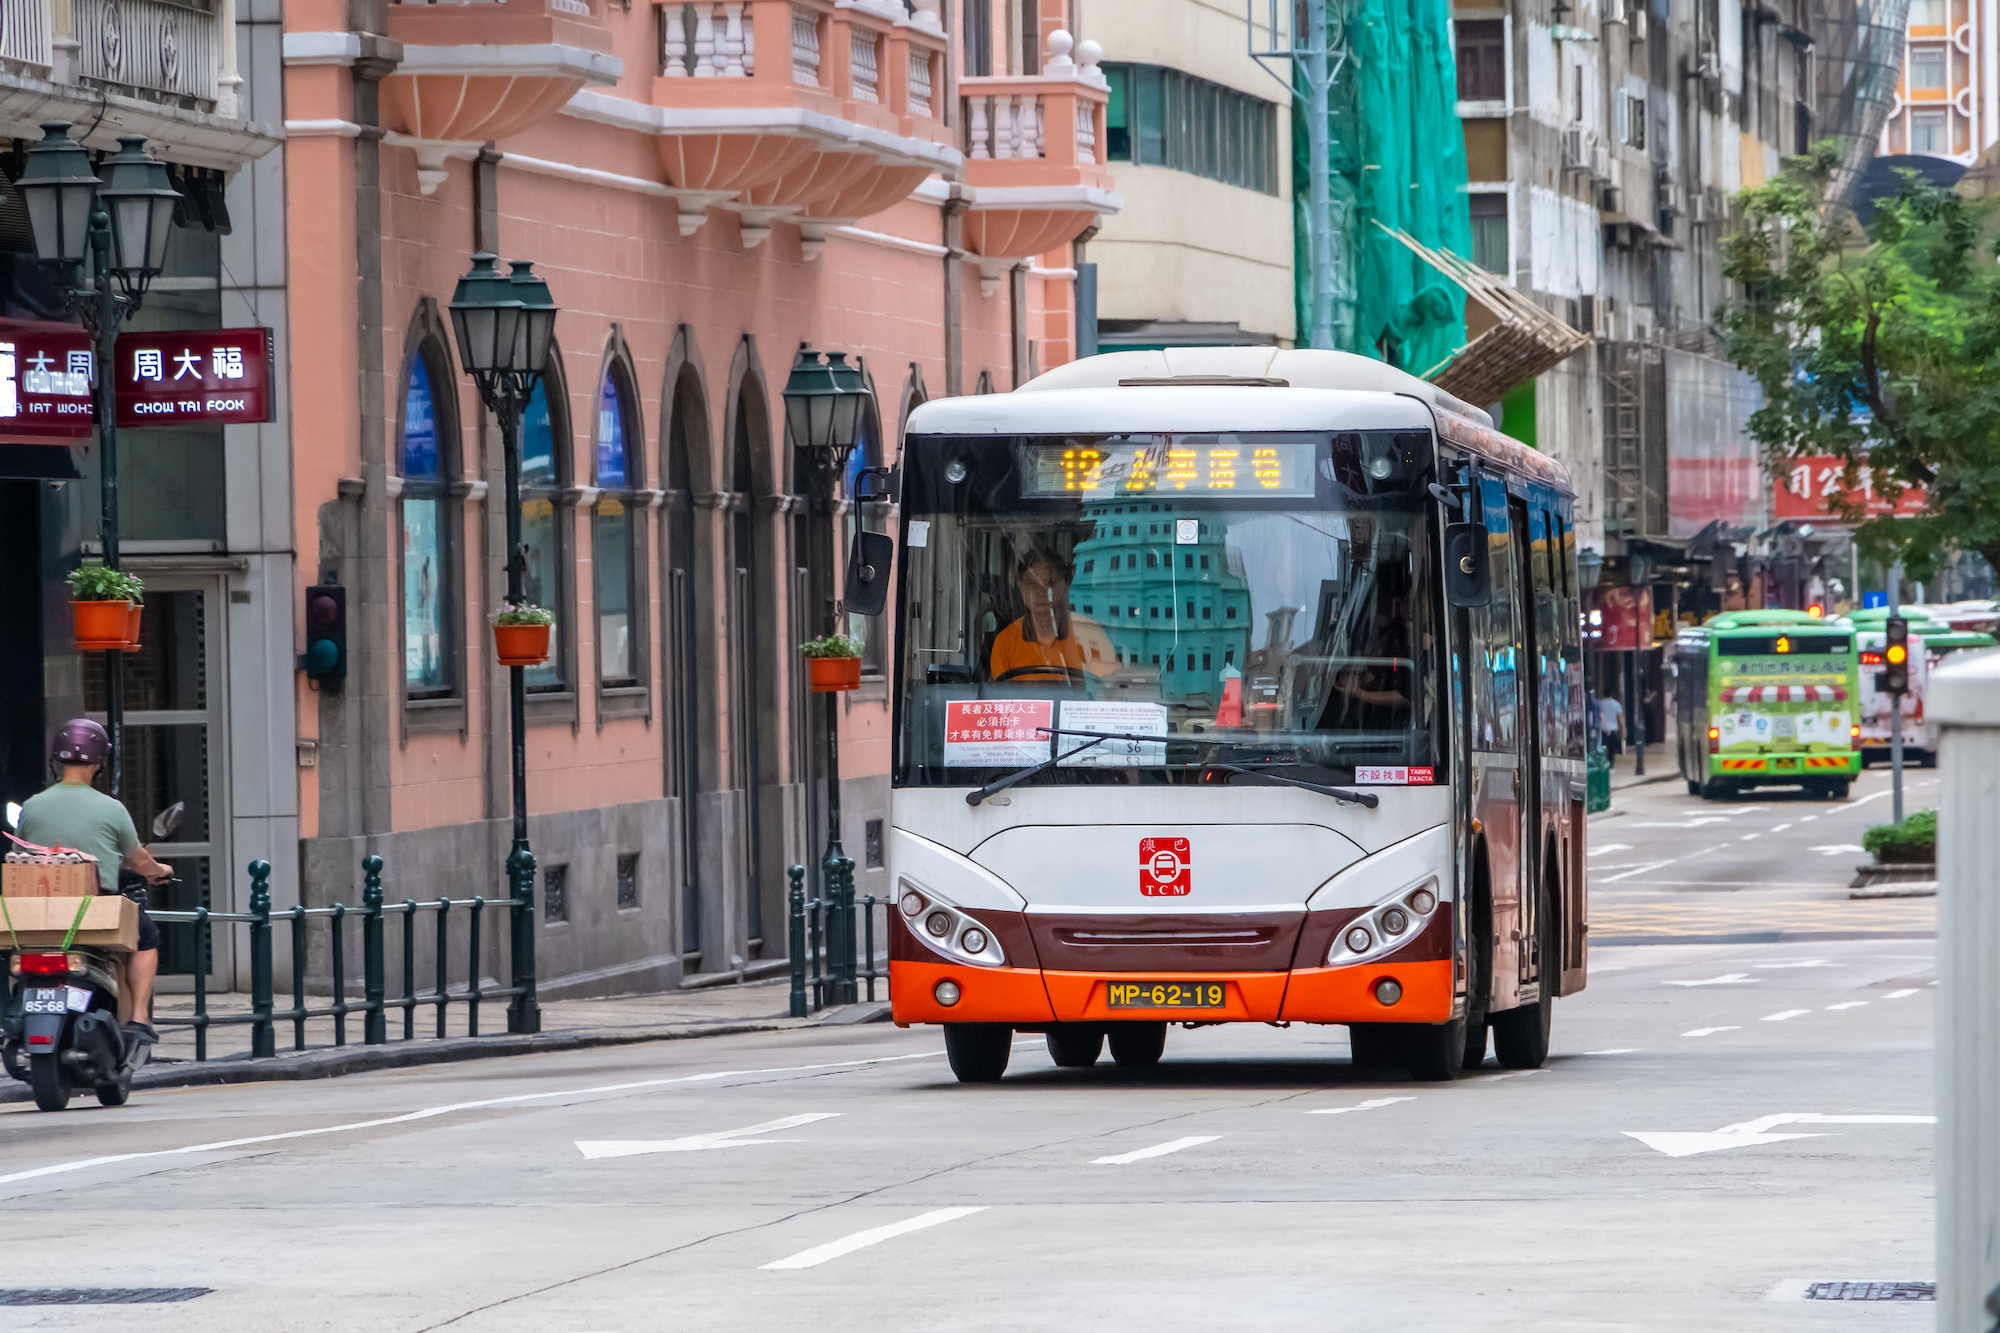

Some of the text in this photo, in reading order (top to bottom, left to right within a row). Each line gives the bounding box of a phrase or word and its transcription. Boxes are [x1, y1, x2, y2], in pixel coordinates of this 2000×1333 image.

[133, 347, 244, 381] 周大福
[133, 399, 245, 414] CHOW TAI FOOK
[976, 717, 1020, 727] 必須拍卡
[1126, 742, 1142, 754] $6
[36, 989, 56, 1000] MM
[1110, 984, 1223, 1006] MP-62-19
[25, 1001, 65, 1012] 85-68
